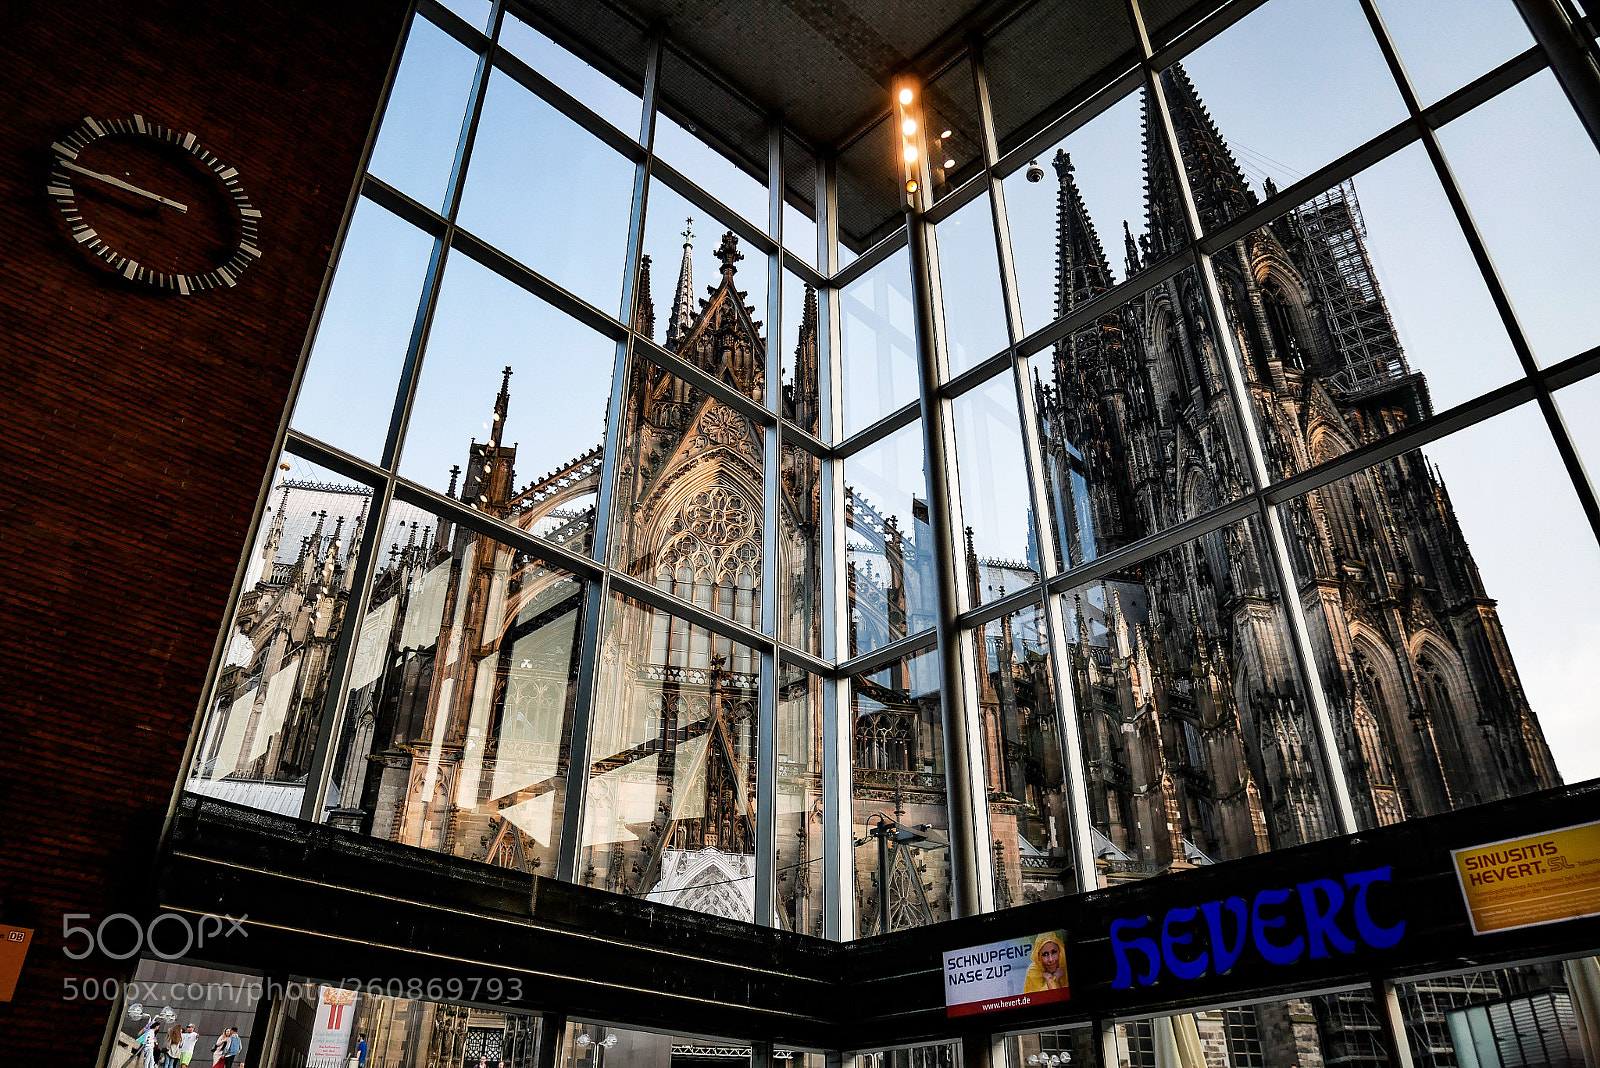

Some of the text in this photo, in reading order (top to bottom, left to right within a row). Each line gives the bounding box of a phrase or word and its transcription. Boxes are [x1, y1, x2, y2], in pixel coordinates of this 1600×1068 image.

[1465, 841, 1558, 871] SINUSITIS
[1110, 865, 1406, 989] HEVERT
[947, 944, 1033, 970] SCHNUPFEN?
[948, 964, 1012, 986] NASE ZU?
[981, 996, 1031, 1011] www.hevert.de
